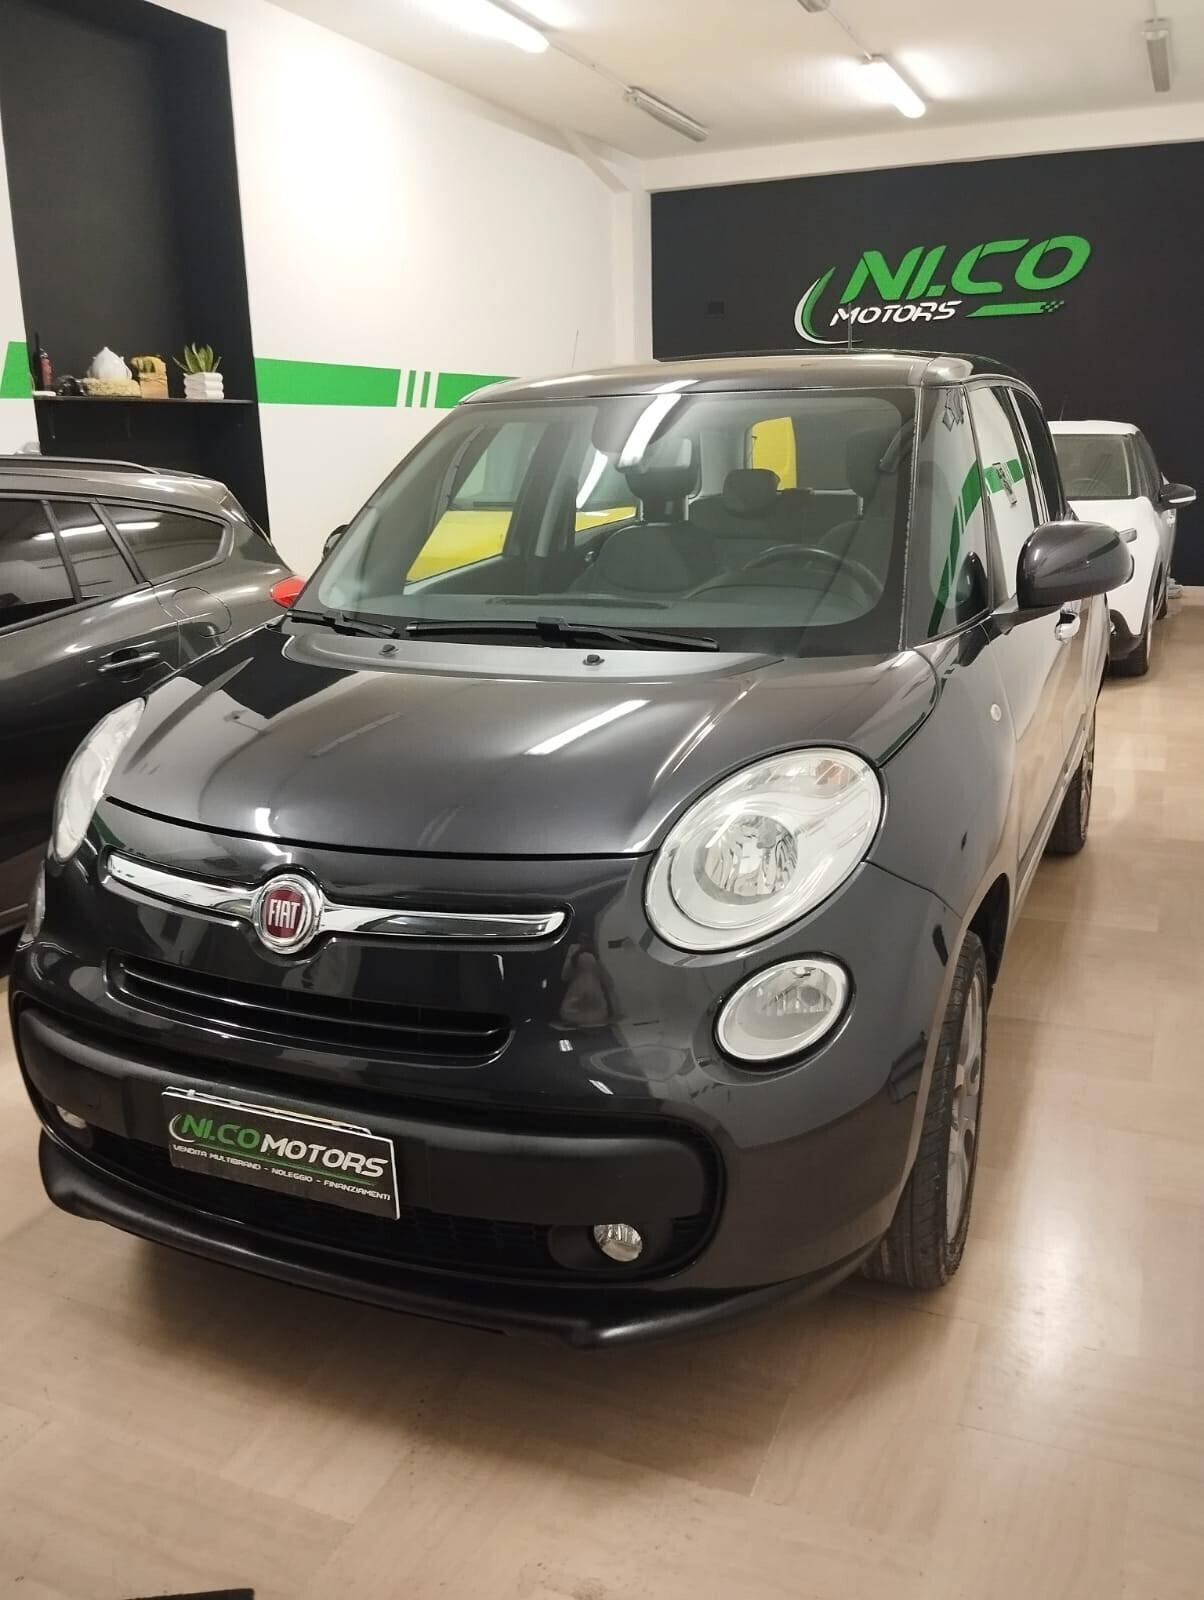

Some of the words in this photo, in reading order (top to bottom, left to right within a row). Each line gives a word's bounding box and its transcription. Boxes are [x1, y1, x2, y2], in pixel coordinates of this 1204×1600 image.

[840, 235, 1091, 304] NI.CO
[829, 300, 963, 327] MOTORS
[267, 898, 301, 930] FIAT
[173, 1143, 208, 1158] VENDITA
[209, 1152, 262, 1171] MULTIBRAND
[271, 1167, 313, 1183] NOLEGGIO
[323, 1180, 391, 1201] FINANZIAMENTI
